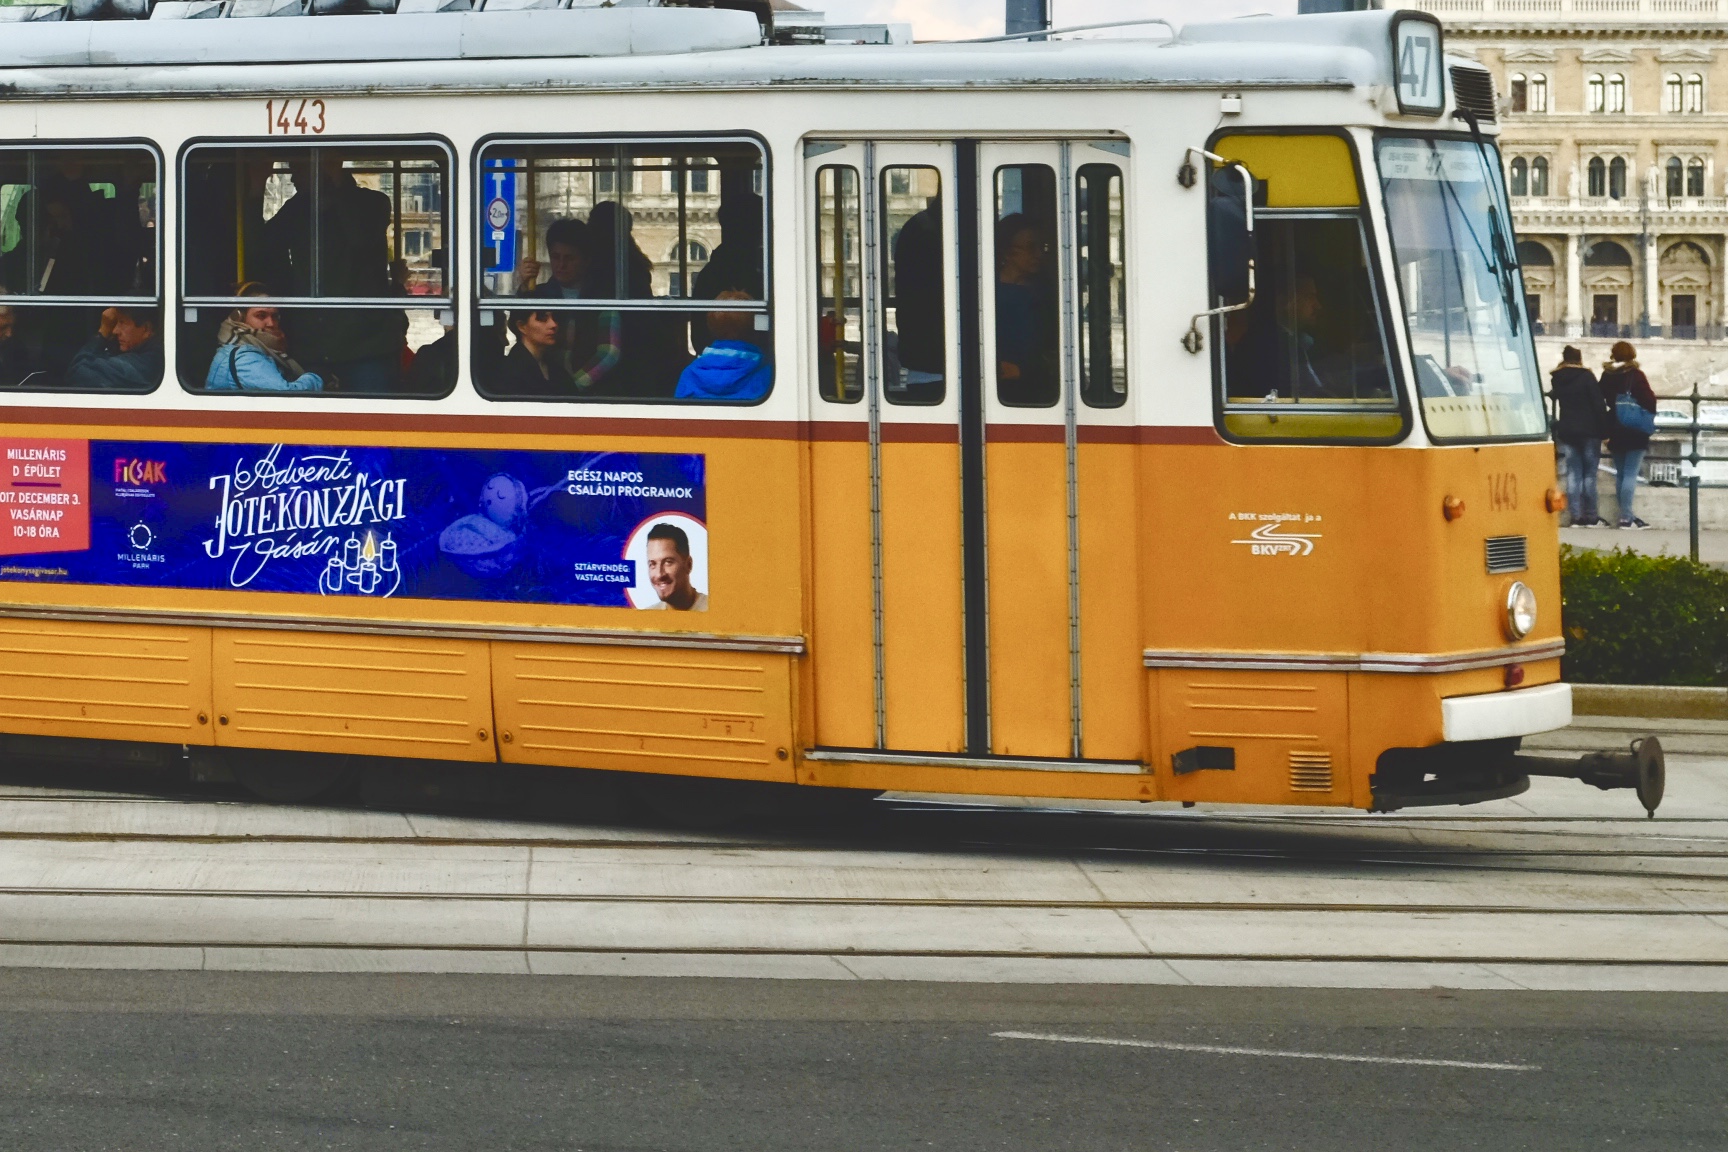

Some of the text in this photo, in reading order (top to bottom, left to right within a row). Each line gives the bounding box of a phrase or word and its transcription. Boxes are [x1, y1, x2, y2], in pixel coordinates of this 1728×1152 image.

[1399, 35, 1431, 97] 47
[266, 99, 325, 134] 1443
[7, 447, 66, 461] MILLENÁRIS
[13, 465, 61, 478] D ÉPÜLET
[234, 443, 353, 491] Adventi
[568, 468, 643, 483] EGÉSZ NAPOS
[567, 483, 693, 499] CSALÁDI PROGRAMOK
[1487, 473, 1517, 512] 1443
[18, 493, 70, 505] DECEMBER
[72, 494, 81, 505] 3.
[10, 508, 64, 521] VASÁRNAP
[202, 472, 407, 558] JÓTÉKONYSÁGI
[13, 524, 60, 538] 10-18 ÓRA
[575, 574, 630, 583] VASTAG CSABA
